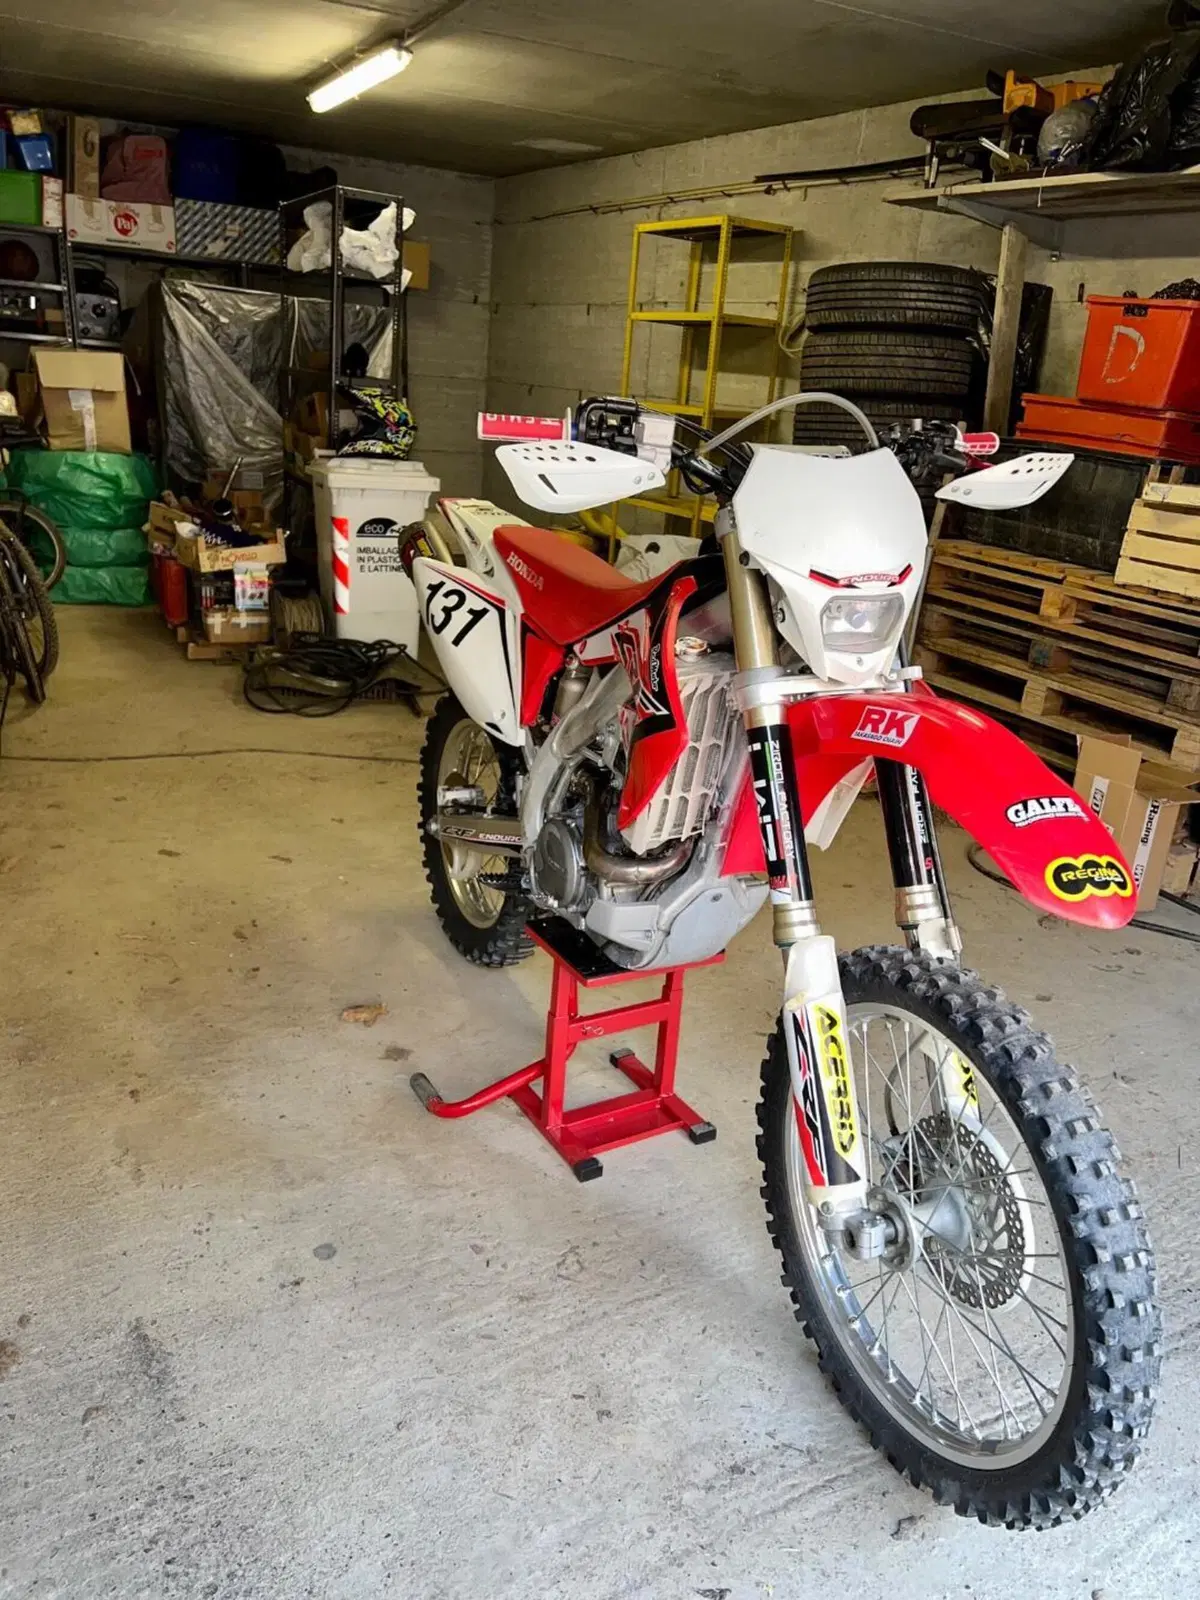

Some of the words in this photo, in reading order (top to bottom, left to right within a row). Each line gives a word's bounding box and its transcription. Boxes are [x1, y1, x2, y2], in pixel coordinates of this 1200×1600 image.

[364, 524, 385, 534] eco
[356, 555, 365, 563] IN
[360, 564, 366, 573] E
[506, 551, 544, 591] HONDA
[426, 580, 490, 648] 131
[857, 708, 916, 739] RK
[441, 825, 476, 837] CRF
[1141, 801, 1160, 845] Racing
[817, 1006, 855, 1154] ACERBIS
